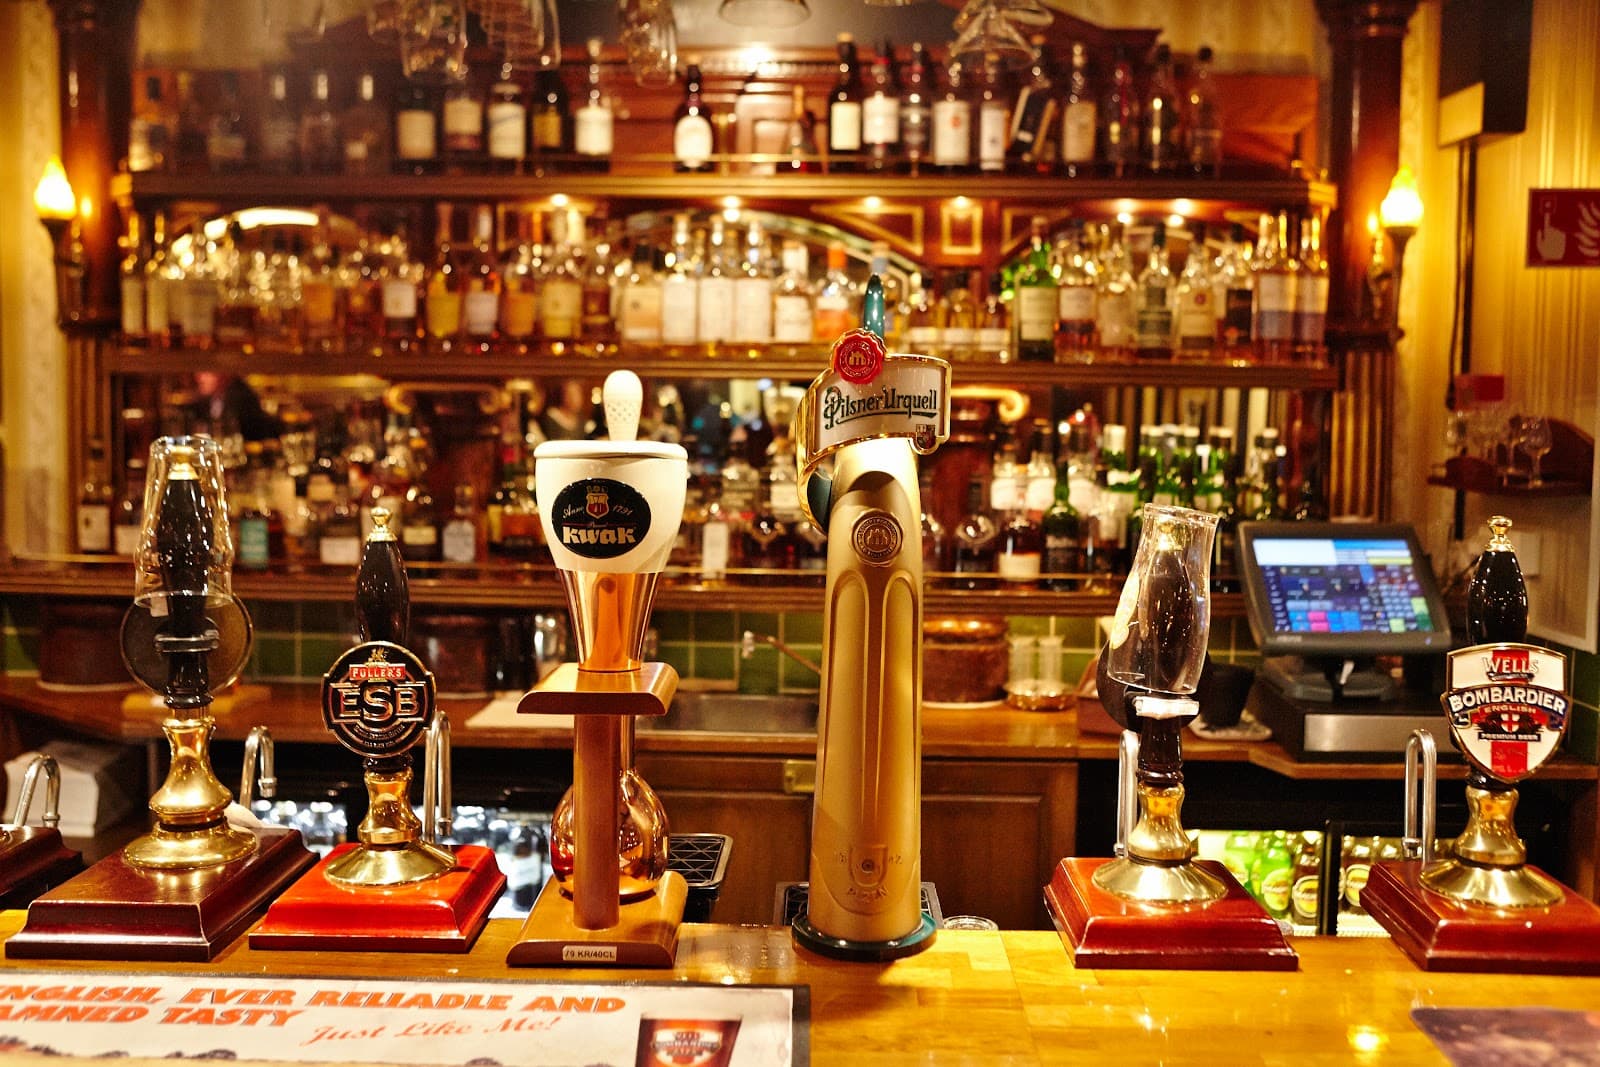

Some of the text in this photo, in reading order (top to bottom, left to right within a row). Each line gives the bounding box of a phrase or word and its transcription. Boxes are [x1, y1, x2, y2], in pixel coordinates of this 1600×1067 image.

[823, 385, 937, 430] Pilsner Urquell
[352, 667, 402, 678] FULLER'S
[1482, 656, 1540, 674] WELLS
[338, 686, 418, 721] ESB
[1448, 686, 1567, 715] BOMBARDIER
[1484, 704, 1537, 714] ENGLISH
[0, 985, 166, 1004] NGLISH,
[178, 988, 296, 1006] EVER
[520, 995, 626, 1014] AND
[158, 1007, 305, 1027] TASTY
[299, 1016, 562, 1047] Just Like Me!
